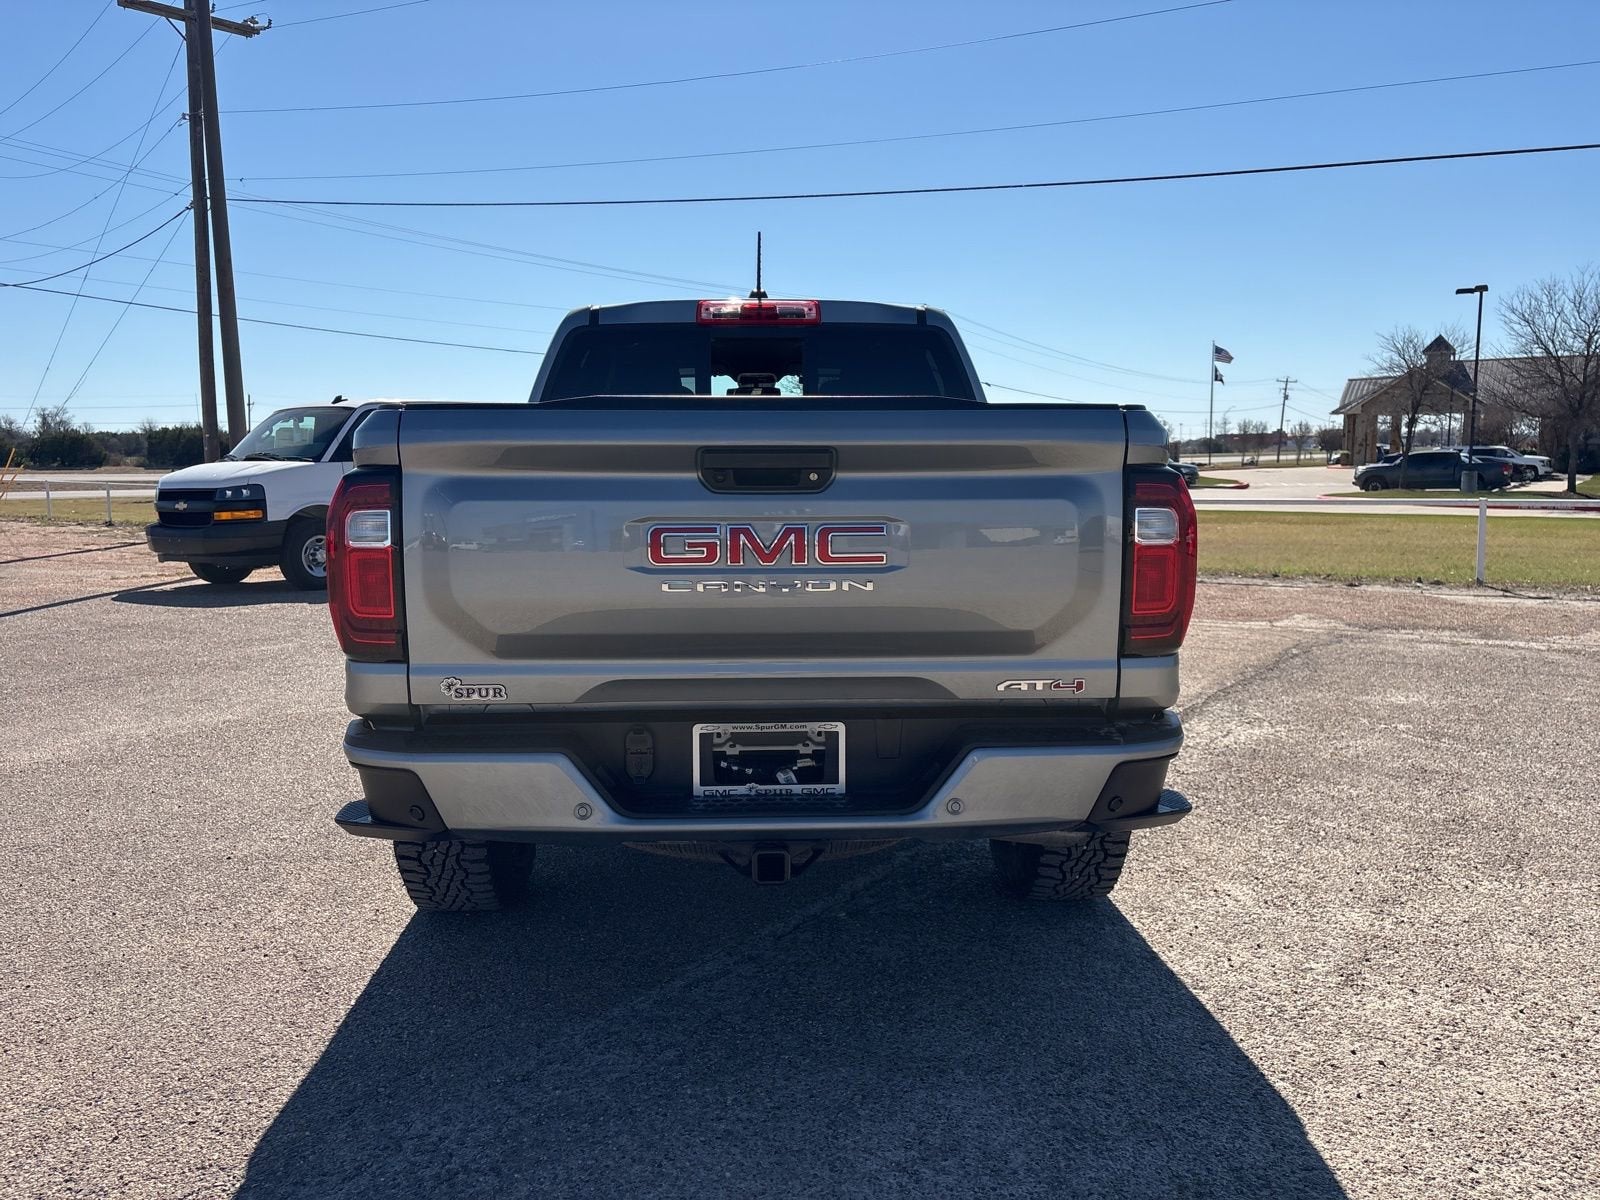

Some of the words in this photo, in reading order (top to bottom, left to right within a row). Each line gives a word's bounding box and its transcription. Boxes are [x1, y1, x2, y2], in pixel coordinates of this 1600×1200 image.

[648, 524, 887, 566] GMC
[661, 580, 874, 592] CANYON
[454, 687, 503, 698] SPUR
[997, 680, 1085, 694] AT4
[731, 723, 807, 731] www.SpurGM.com
[801, 787, 836, 795] GMC
